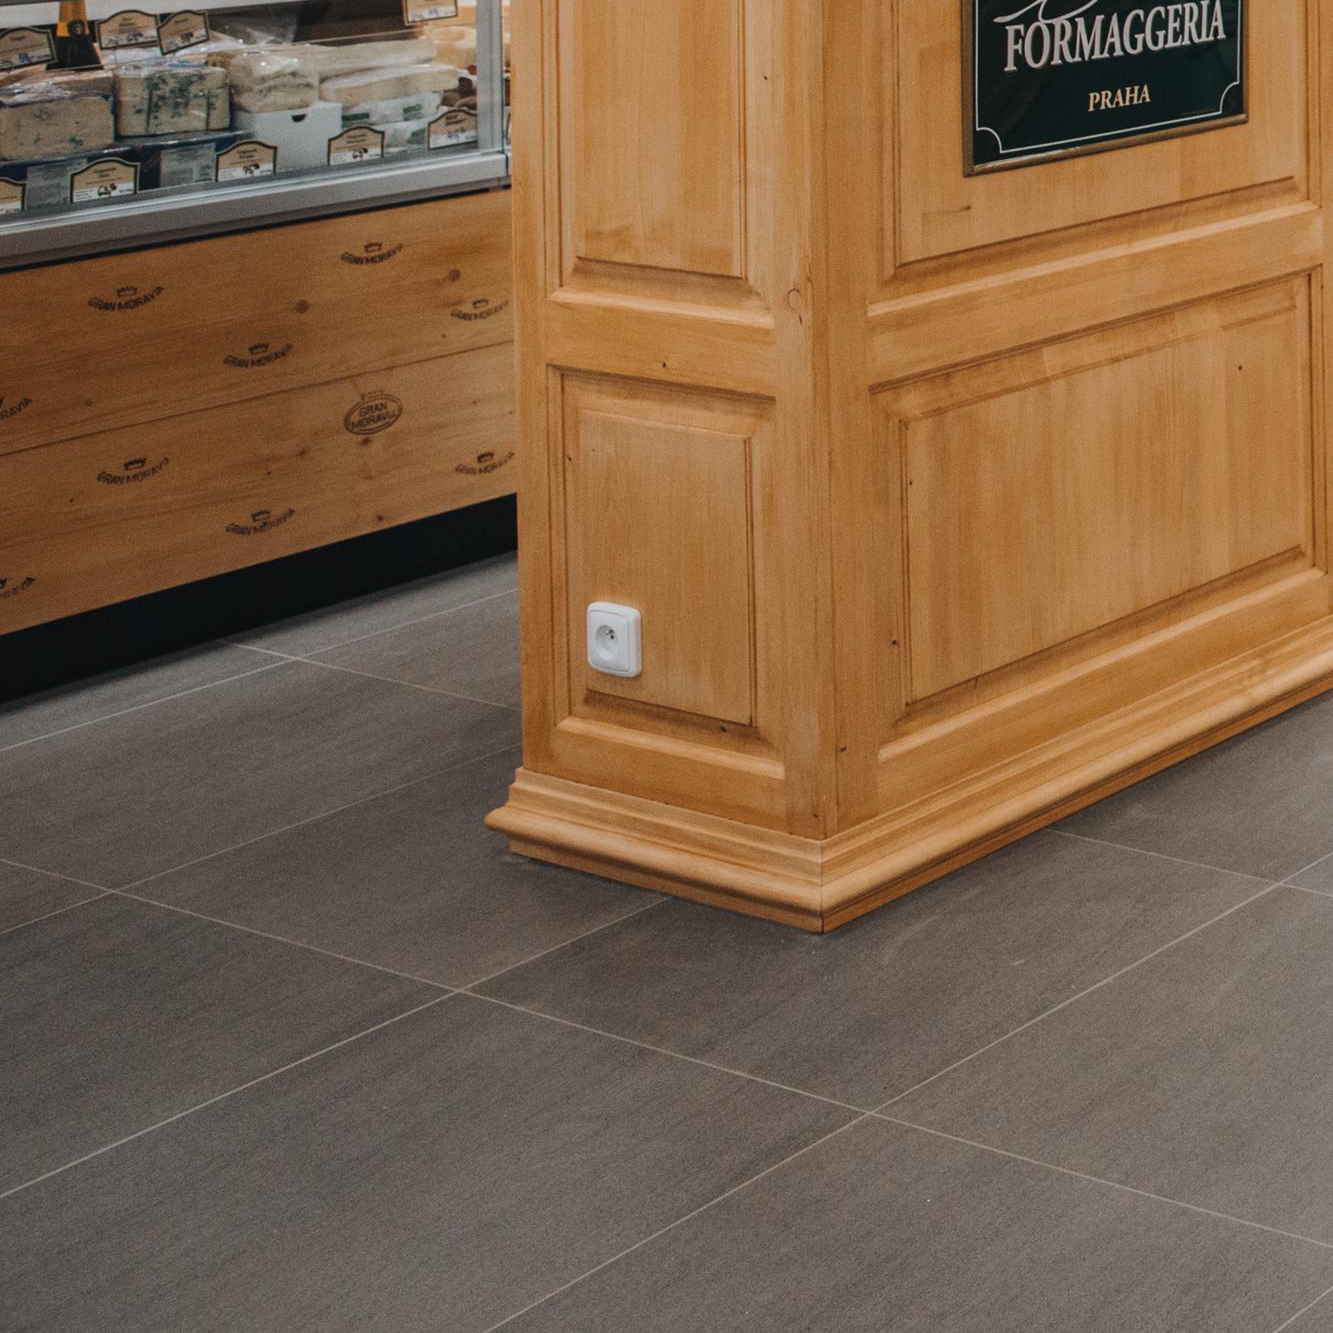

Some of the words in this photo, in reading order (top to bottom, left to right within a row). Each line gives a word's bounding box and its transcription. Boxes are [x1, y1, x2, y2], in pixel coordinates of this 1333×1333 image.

[1087, 84, 1151, 112] PRAHA
[88, 297, 116, 312] GRAN
[117, 285, 164, 311] MORAVIA
[359, 402, 388, 417] GRAN
